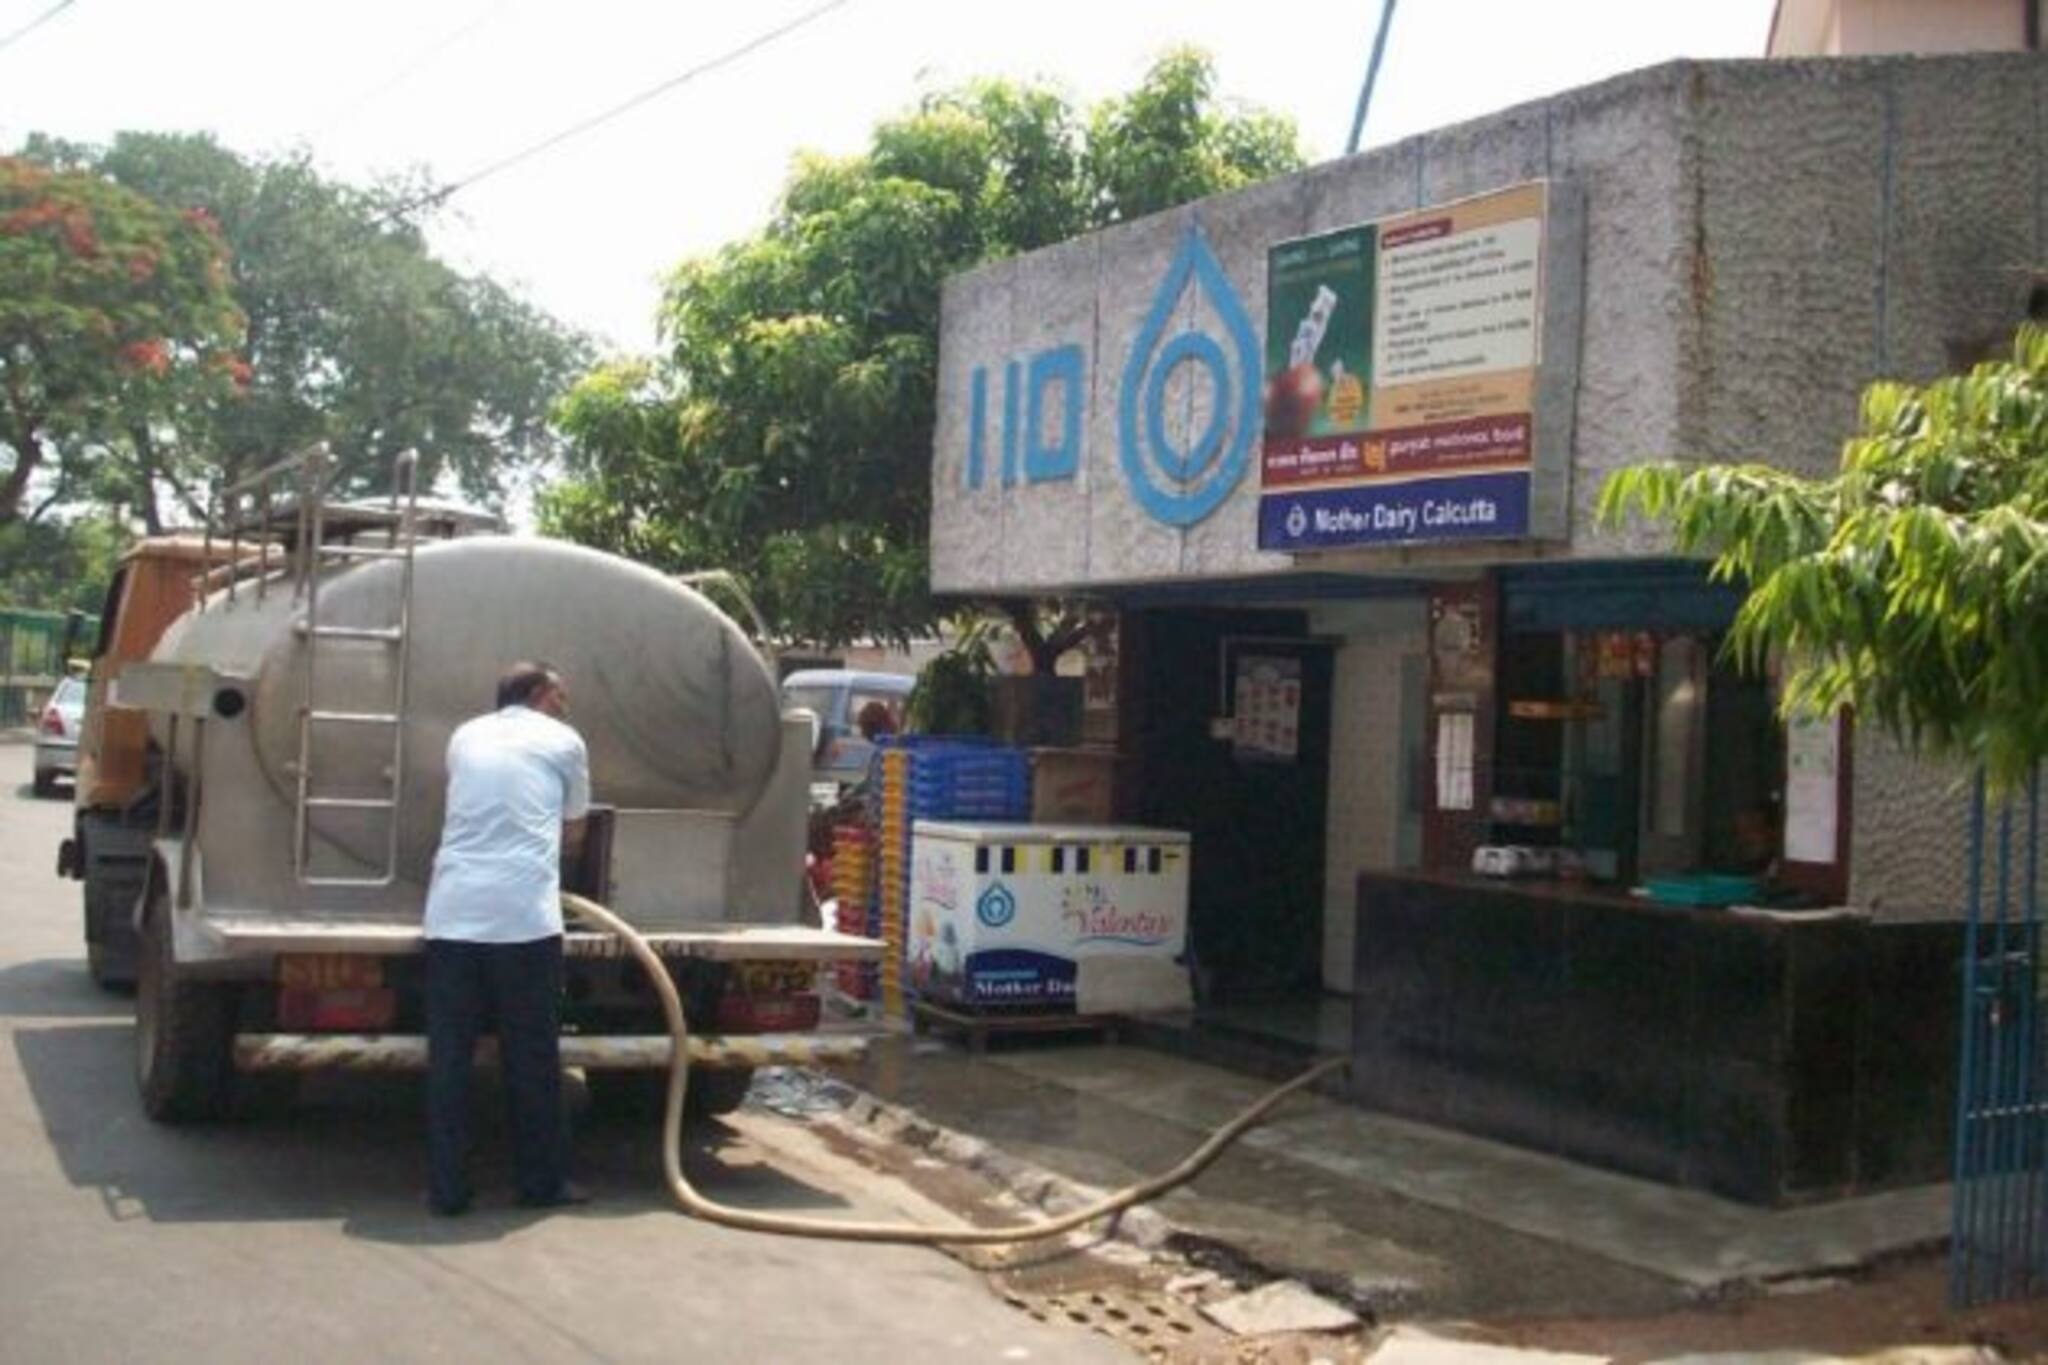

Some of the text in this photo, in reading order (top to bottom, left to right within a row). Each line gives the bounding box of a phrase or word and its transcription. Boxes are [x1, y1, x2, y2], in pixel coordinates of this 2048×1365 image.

[1315, 499, 1497, 533] Mother Dairy Calcutta
